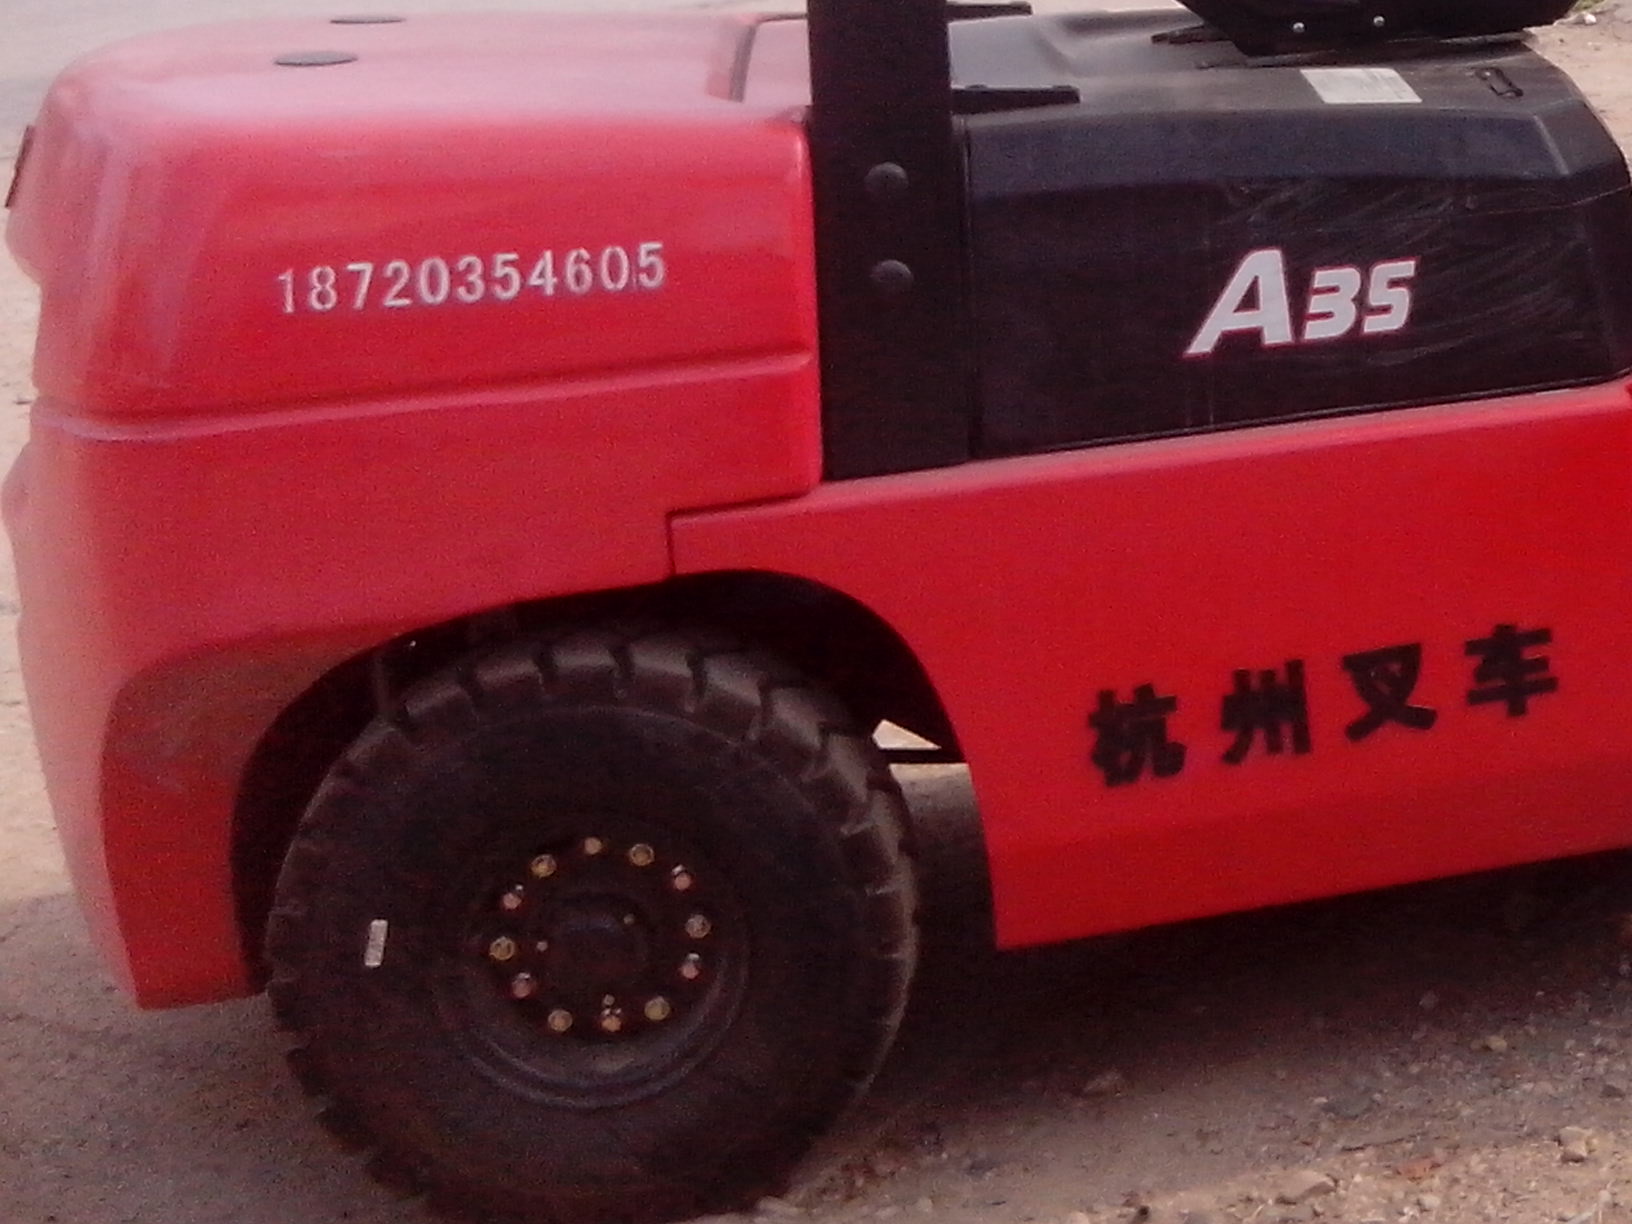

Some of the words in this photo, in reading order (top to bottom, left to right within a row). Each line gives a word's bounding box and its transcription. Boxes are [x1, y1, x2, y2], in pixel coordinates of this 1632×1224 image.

[277, 241, 667, 315] 18720354605
[1086, 623, 1560, 788] 杭州叉车
